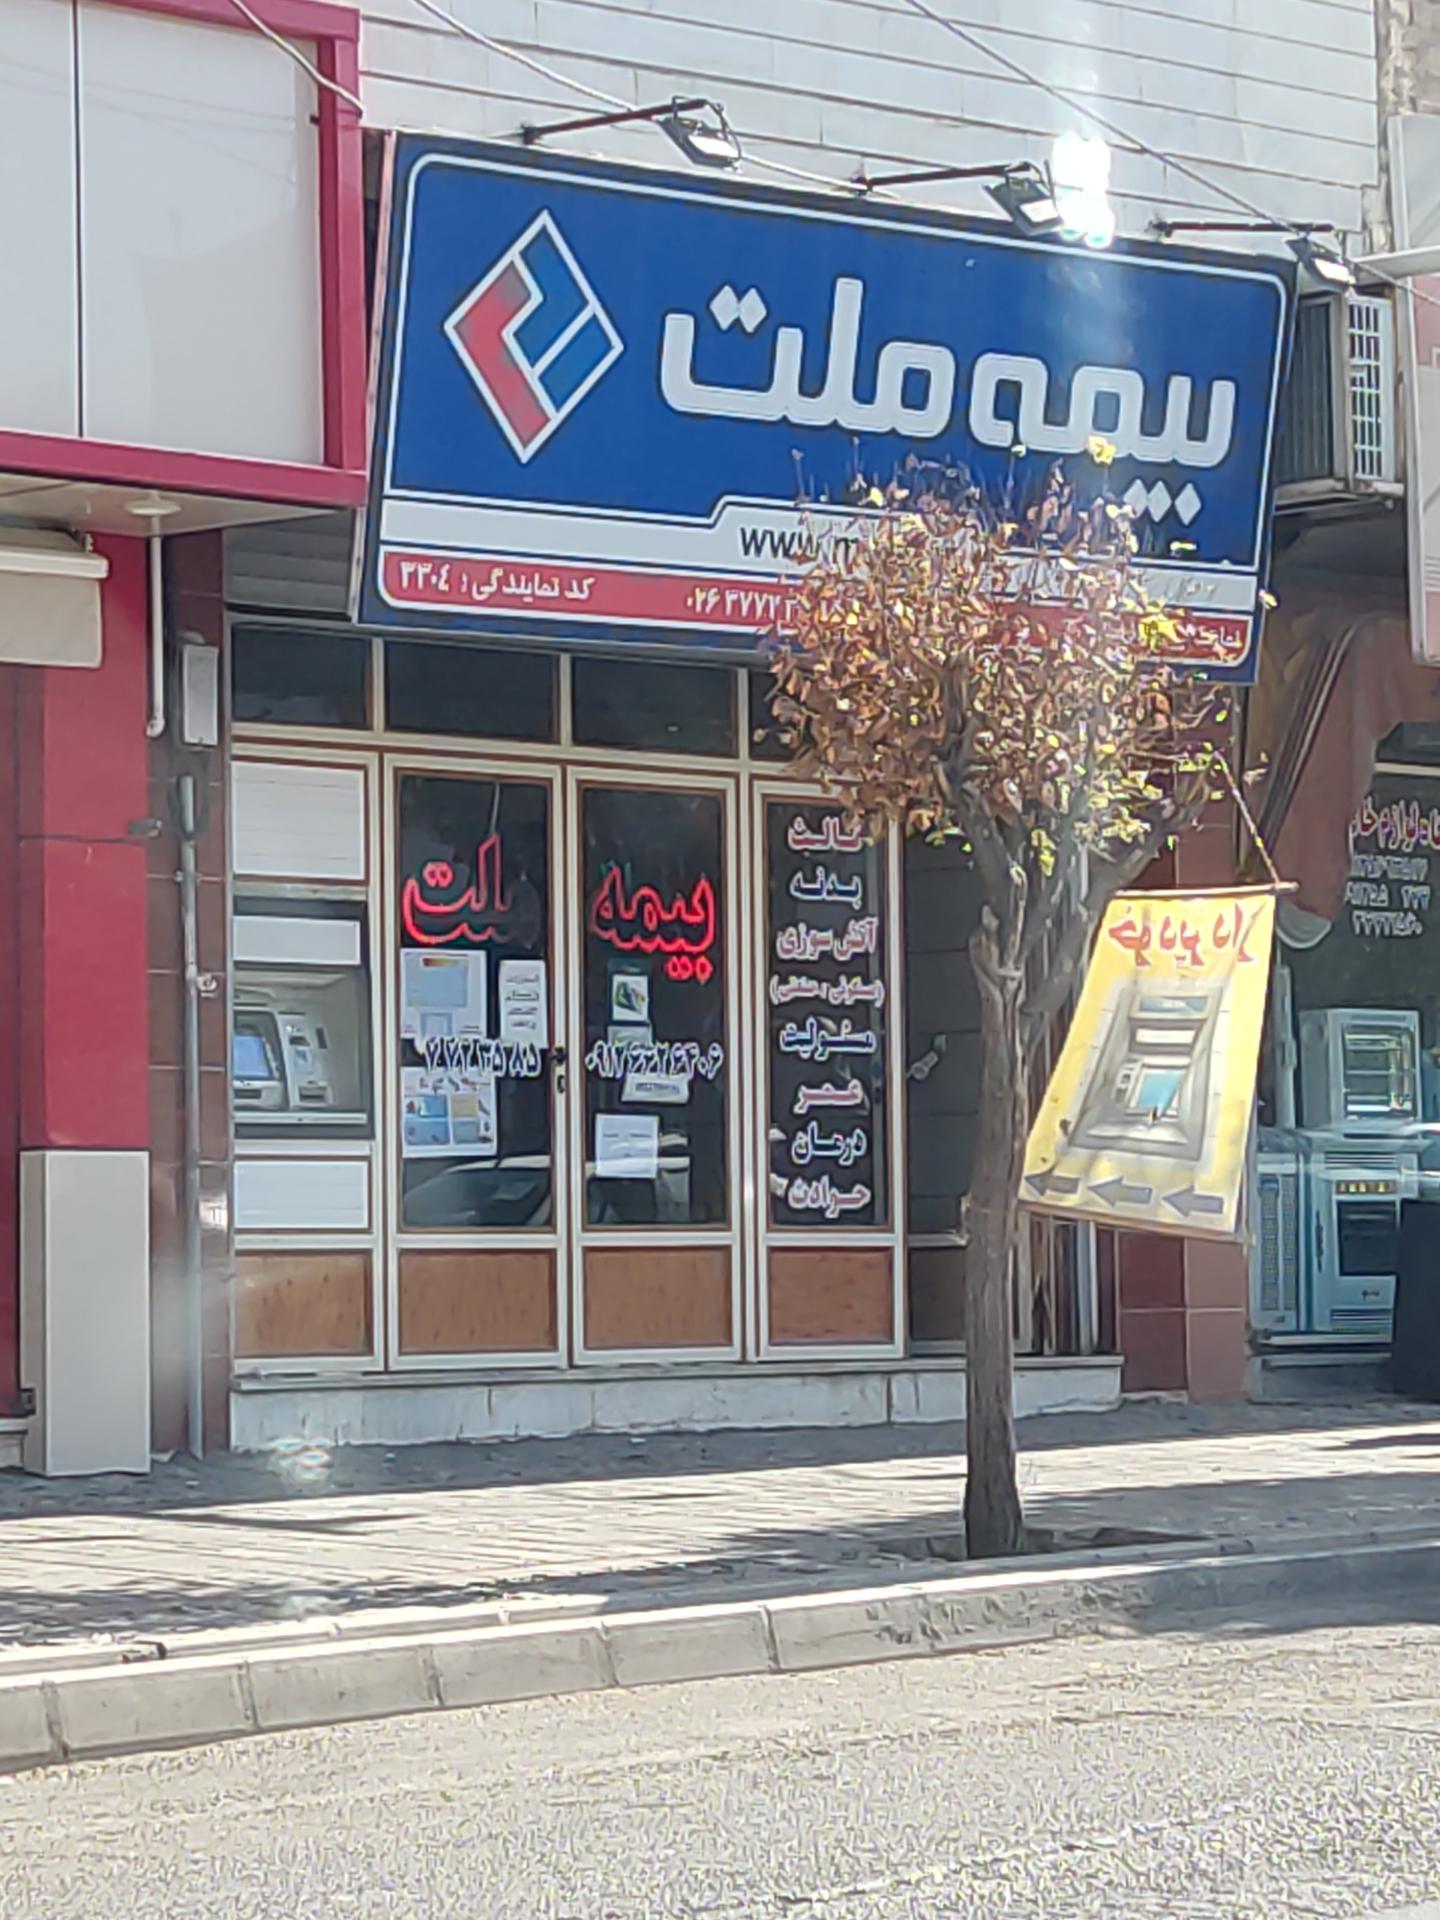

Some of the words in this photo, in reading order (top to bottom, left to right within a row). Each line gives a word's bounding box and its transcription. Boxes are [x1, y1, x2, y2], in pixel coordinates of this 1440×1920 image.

[661, 276, 956, 438] ملت
[968, 351, 1237, 526] بیمه
[564, 576, 595, 600] کد
[789, 865, 862, 910] بدنه
[590, 866, 715, 983] بیمه
[776, 922, 834, 961] سوزی
[794, 1079, 864, 1114] عمر
[792, 1121, 866, 1165] درمان
[788, 1175, 871, 1218] حوادث
